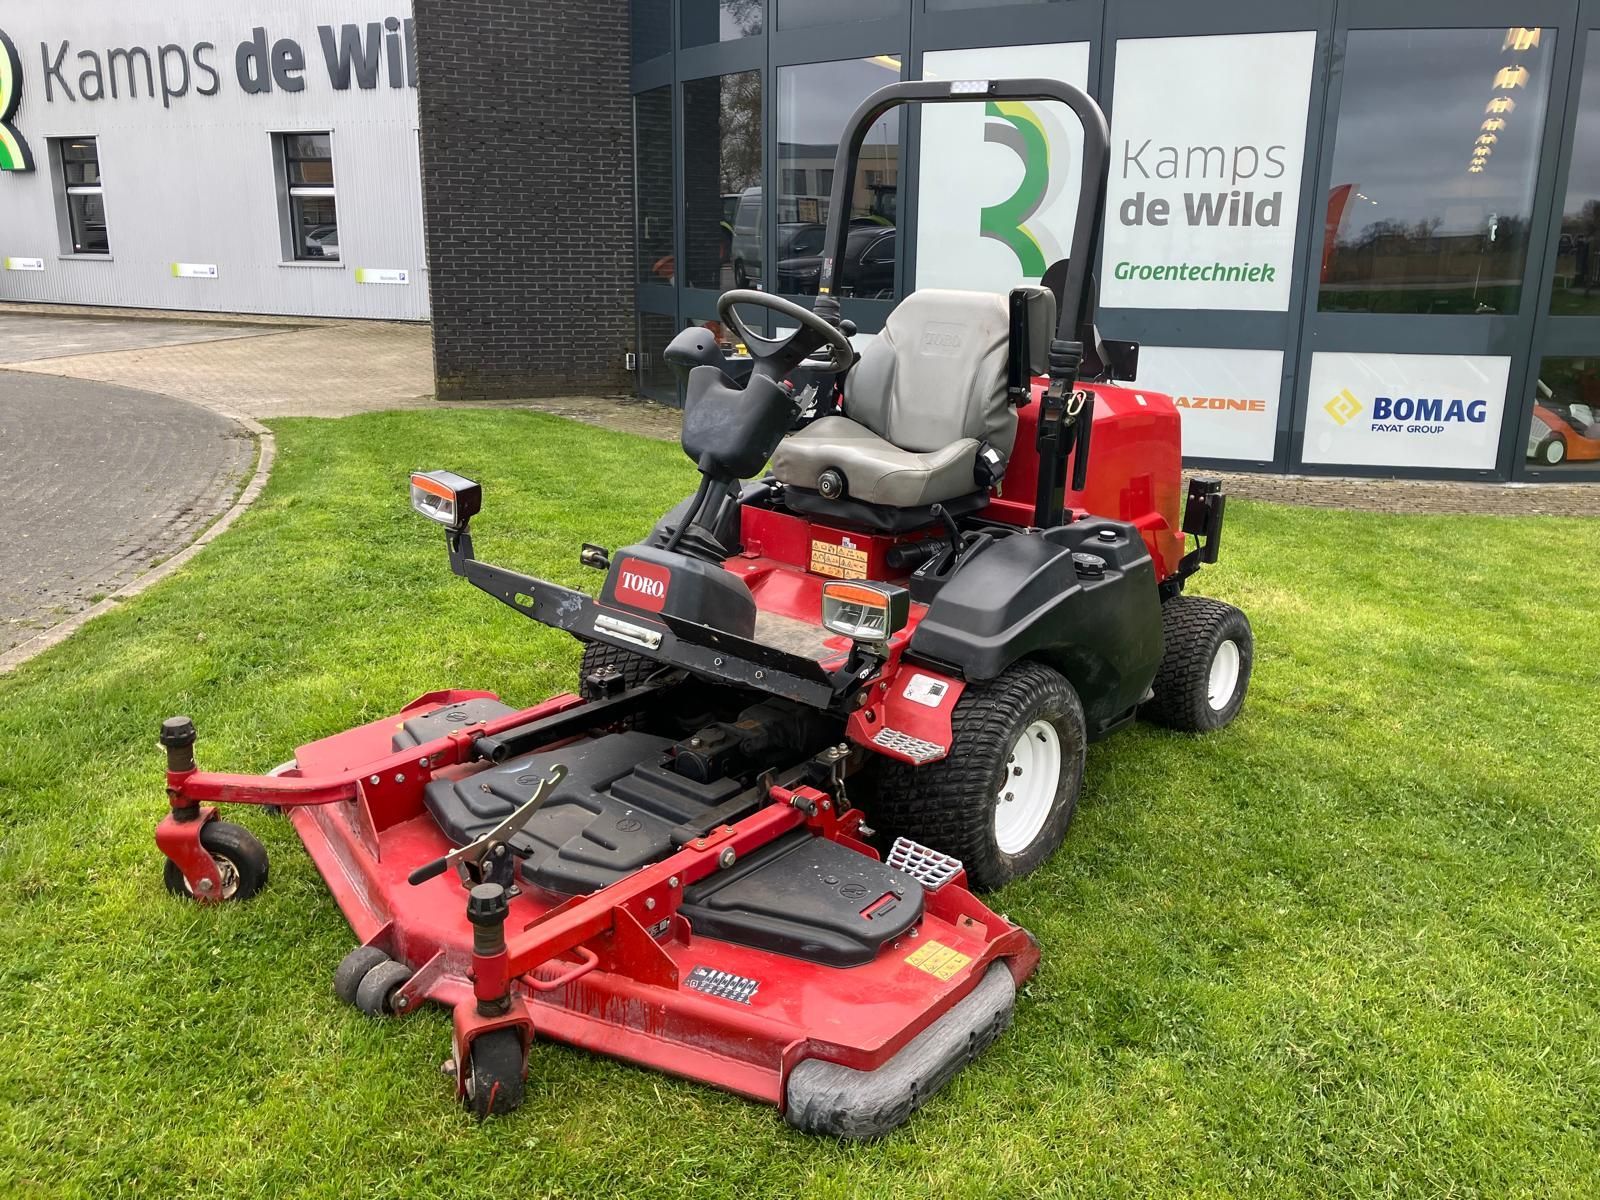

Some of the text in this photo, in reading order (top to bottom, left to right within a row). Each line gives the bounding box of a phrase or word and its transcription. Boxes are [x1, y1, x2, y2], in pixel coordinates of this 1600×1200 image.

[41, 16, 418, 108] Kamps de Wil
[1123, 139, 1285, 185] Kamps
[1120, 190, 1283, 227] de Wild
[1114, 261, 1275, 282] Groentechniek
[1171, 396, 1266, 411] AZONE
[1372, 397, 1487, 423] BOMAG
[1371, 423, 1445, 434] FAYAT GROUP
[622, 571, 664, 598] TORO
